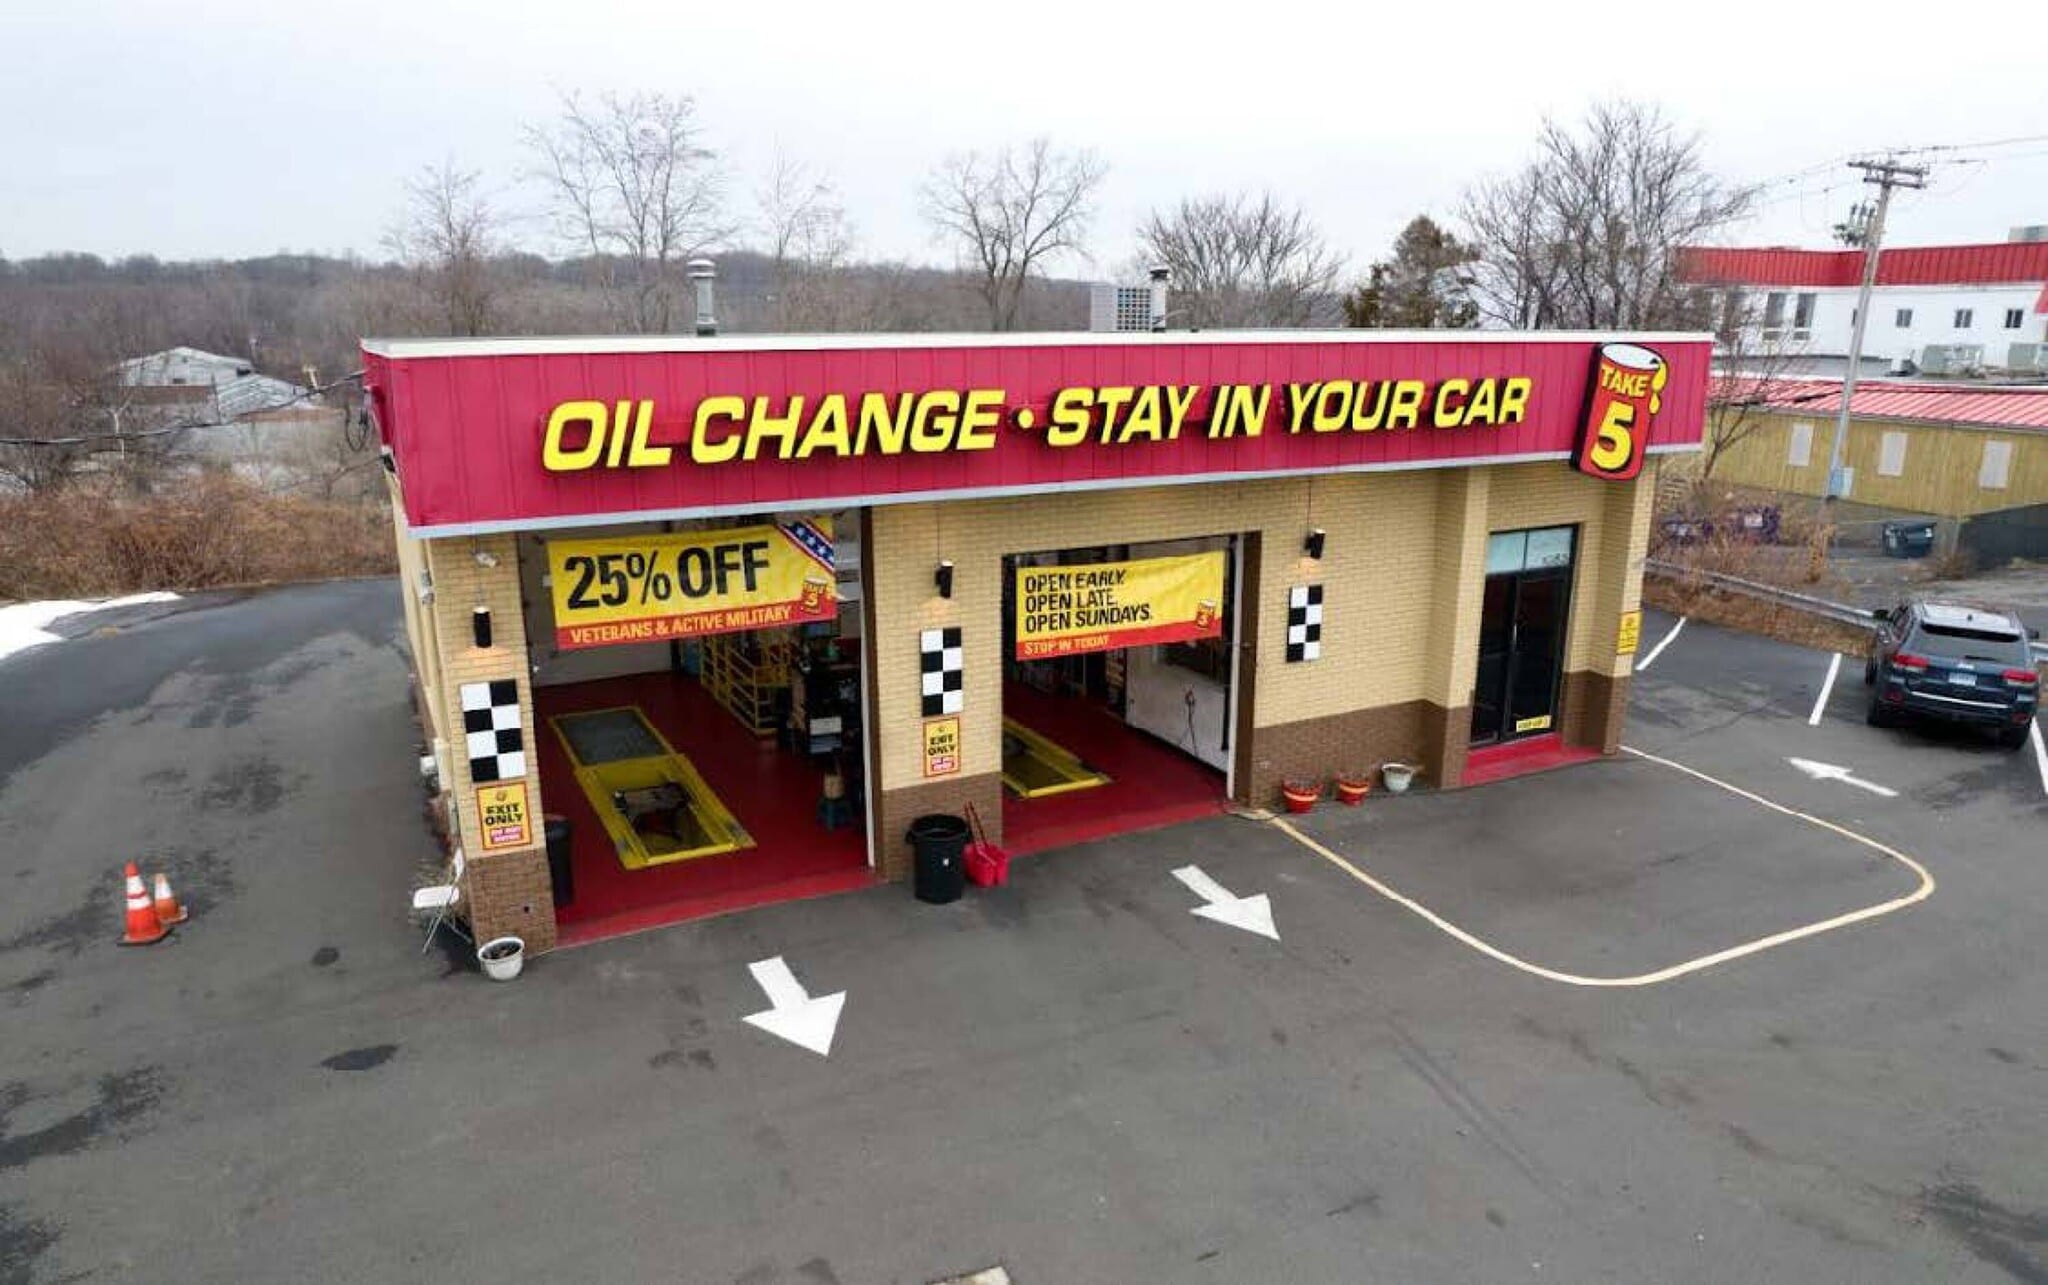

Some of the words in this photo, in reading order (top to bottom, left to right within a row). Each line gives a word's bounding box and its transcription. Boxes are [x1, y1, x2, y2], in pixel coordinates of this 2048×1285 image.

[1600, 362, 1649, 398] TAKE
[542, 400, 672, 472] OIL
[690, 390, 1006, 464] CHANGE
[1047, 384, 1200, 447] STAY
[1208, 384, 1272, 439] IN
[1289, 379, 1425, 434] YOUR
[1434, 377, 1532, 428] CAR
[1590, 400, 1634, 470] 5
[564, 550, 672, 611] 25%
[677, 540, 770, 599] OFF
[1025, 574, 1071, 594] OPEN
[1026, 592, 1071, 613] OPEN
[570, 620, 653, 643] VETERANS
[655, 619, 669, 635] &
[671, 613, 724, 633] ACTIVE
[726, 604, 792, 627] MILITARY
[1026, 611, 1071, 633] OPEN
[1024, 640, 1056, 656] STOP
[1059, 638, 1072, 651] IN
[1075, 634, 1109, 650] TODAY
[485, 813, 522, 825] ONLY
[486, 802, 519, 814] EXIT
